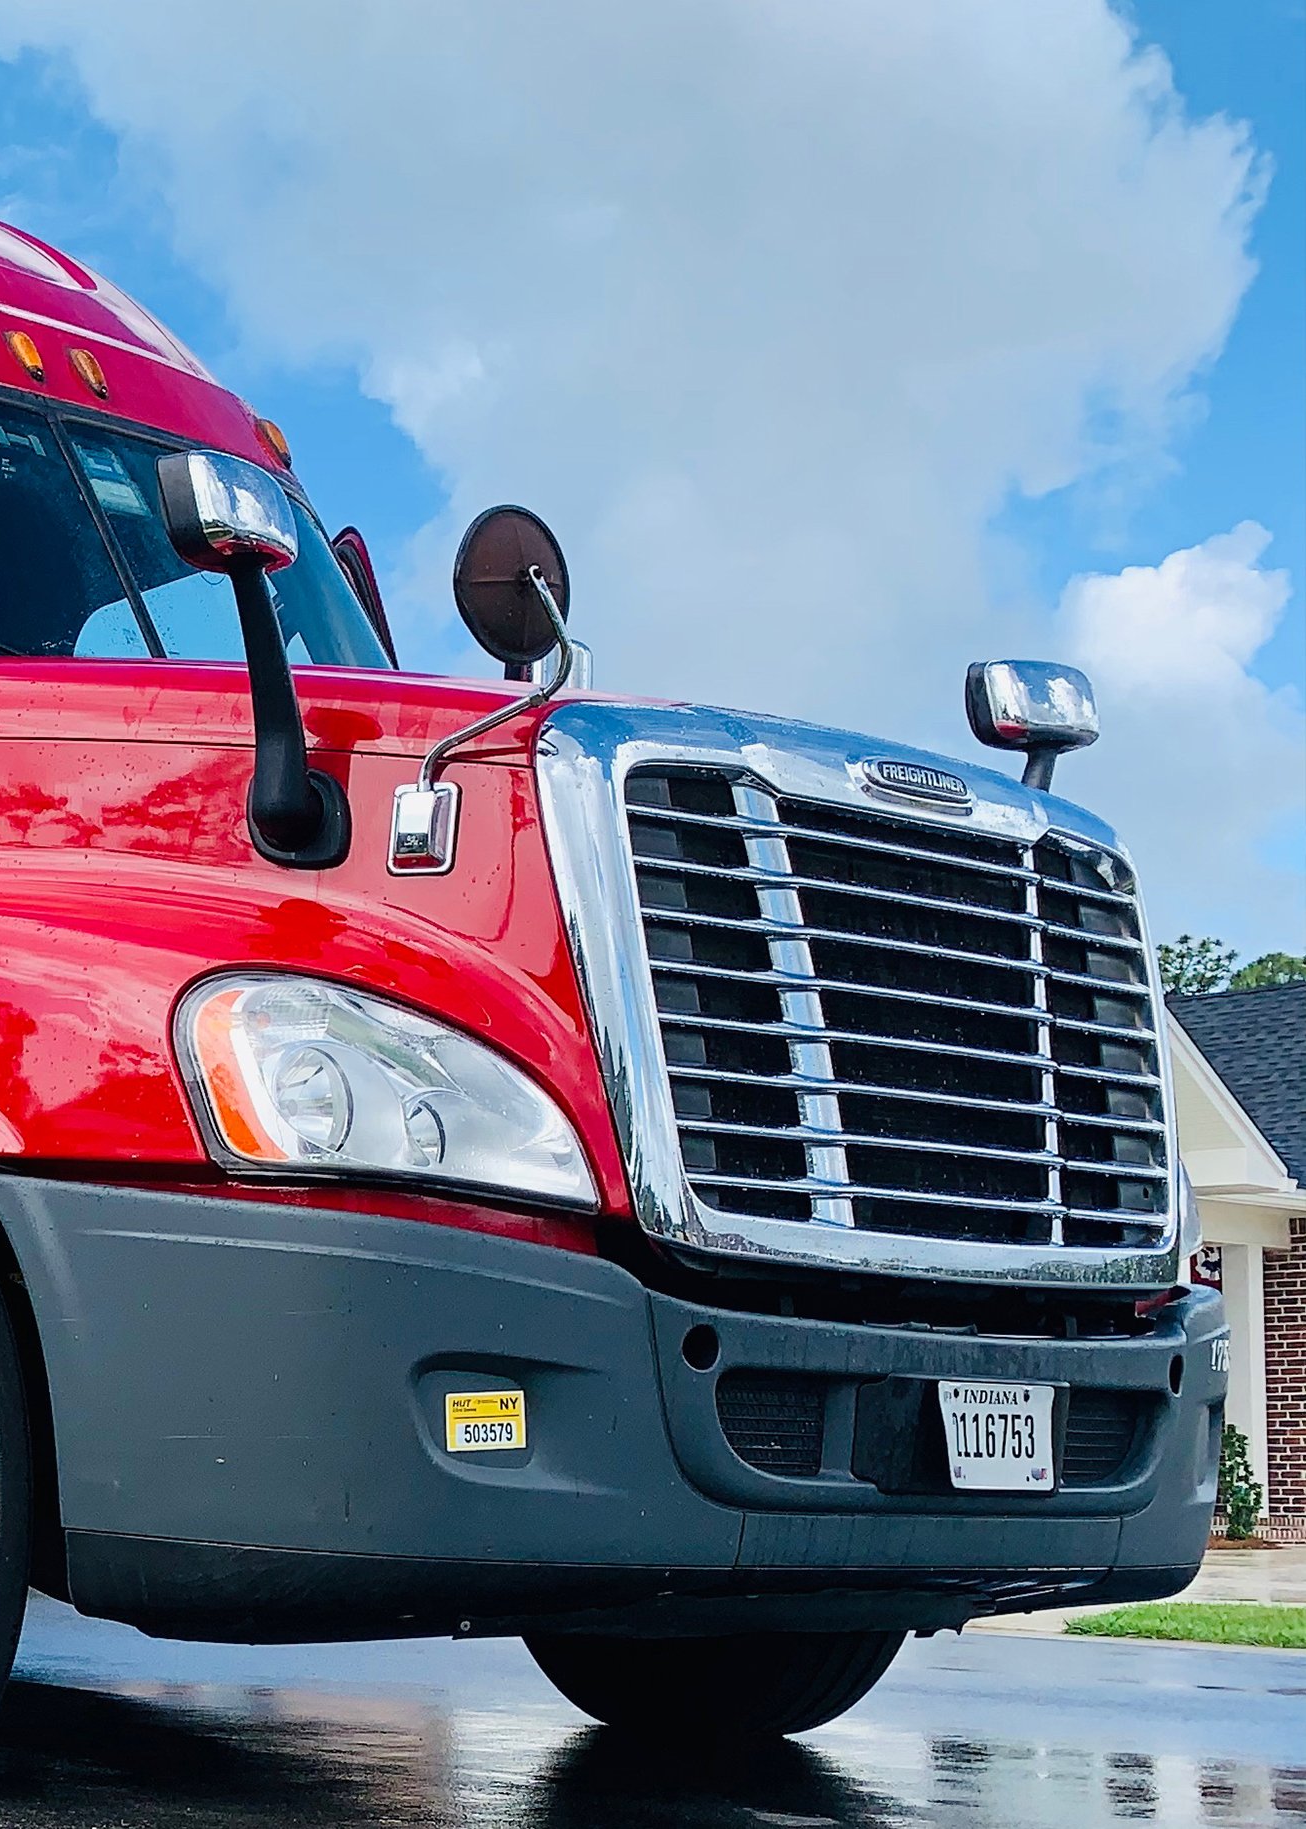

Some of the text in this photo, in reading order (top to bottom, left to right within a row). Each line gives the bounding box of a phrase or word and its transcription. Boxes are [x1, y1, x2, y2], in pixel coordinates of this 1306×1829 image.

[882, 764, 965, 793] FREIGHTLINER
[452, 1399, 471, 1408] HUT
[499, 1397, 519, 1410] NY
[963, 1389, 1018, 1405] INDIANA
[464, 1422, 513, 1443] 503579
